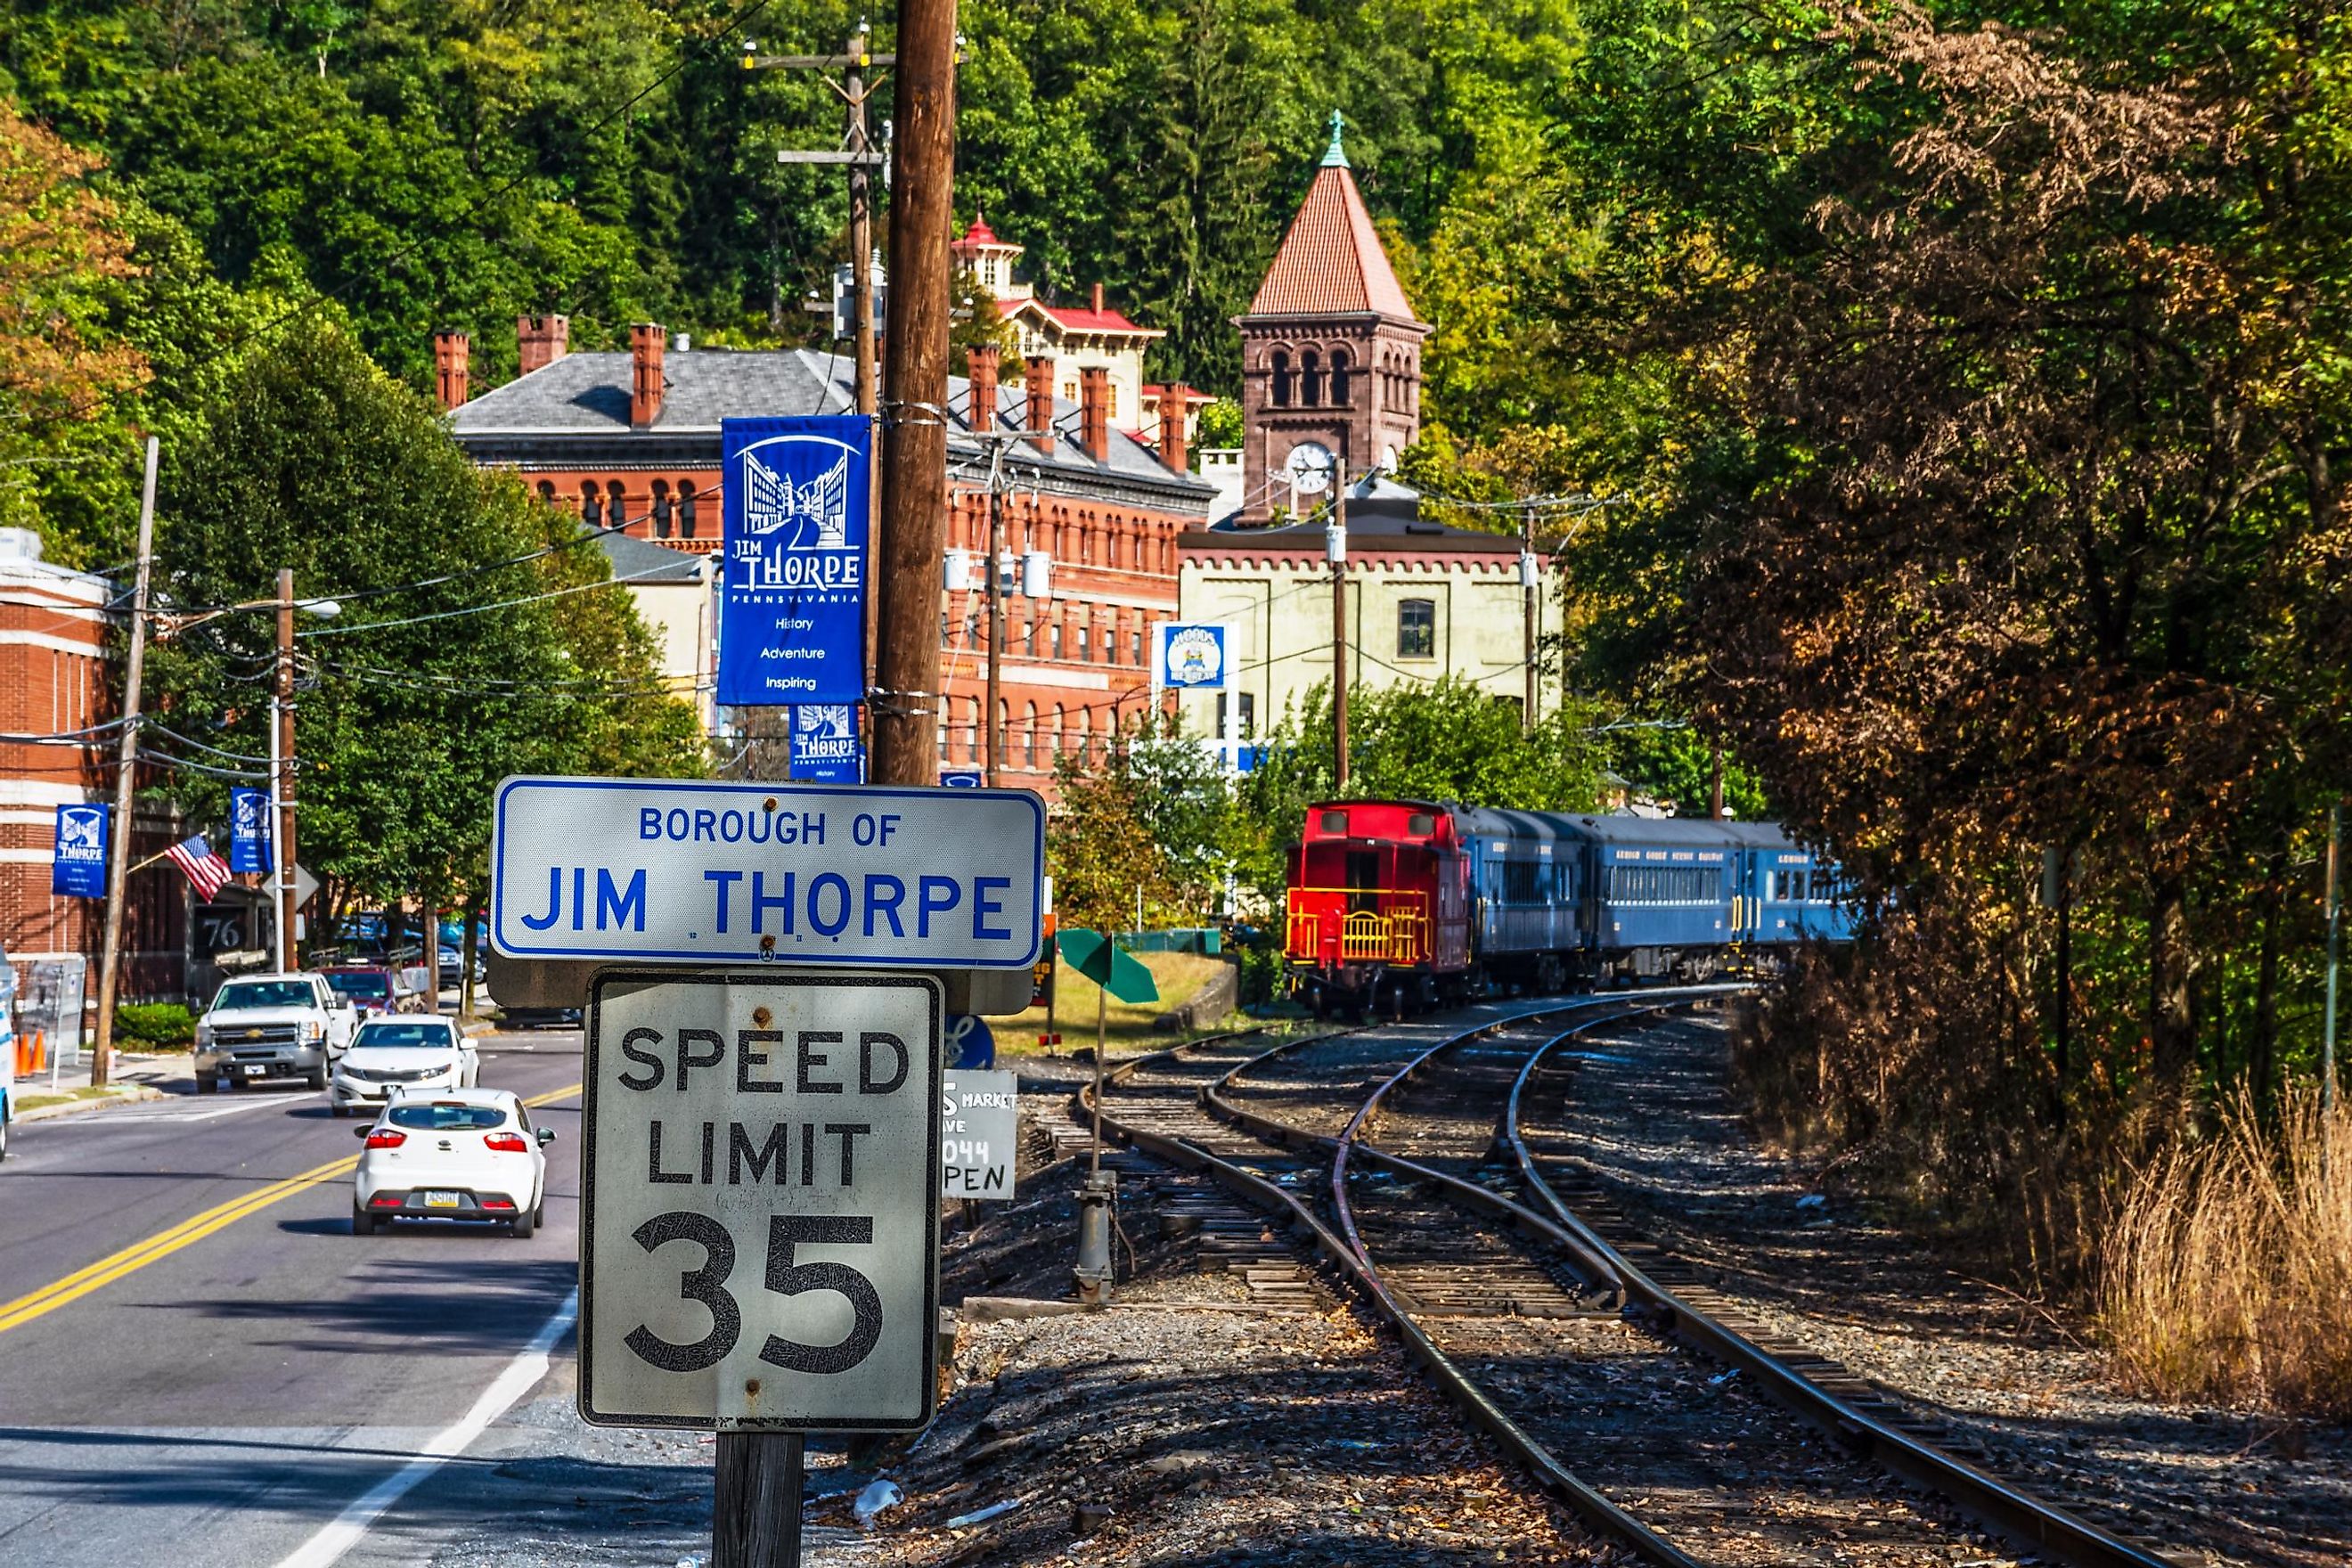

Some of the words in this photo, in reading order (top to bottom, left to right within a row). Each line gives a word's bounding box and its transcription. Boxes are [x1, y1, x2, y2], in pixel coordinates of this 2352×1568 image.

[731, 540, 763, 559] JIM
[739, 543, 861, 592] THORPE
[731, 595, 859, 604] PENNSYLVANIA
[775, 617, 813, 632] History
[760, 647, 826, 659] Adventure
[766, 676, 817, 690] Inspiring
[794, 733, 809, 745] JIM
[797, 736, 856, 760] THORPE
[639, 807, 826, 845] BOROUGH
[853, 813, 902, 847] OF
[520, 866, 647, 933] JIM
[704, 870, 1012, 941] THORPE
[203, 919, 240, 947] 76
[617, 1026, 910, 1095] SPEED
[961, 1091, 1017, 1109] MARKET
[648, 1120, 871, 1187] LIMIT
[944, 1164, 1005, 1190] PEN
[623, 1211, 884, 1375] 35
